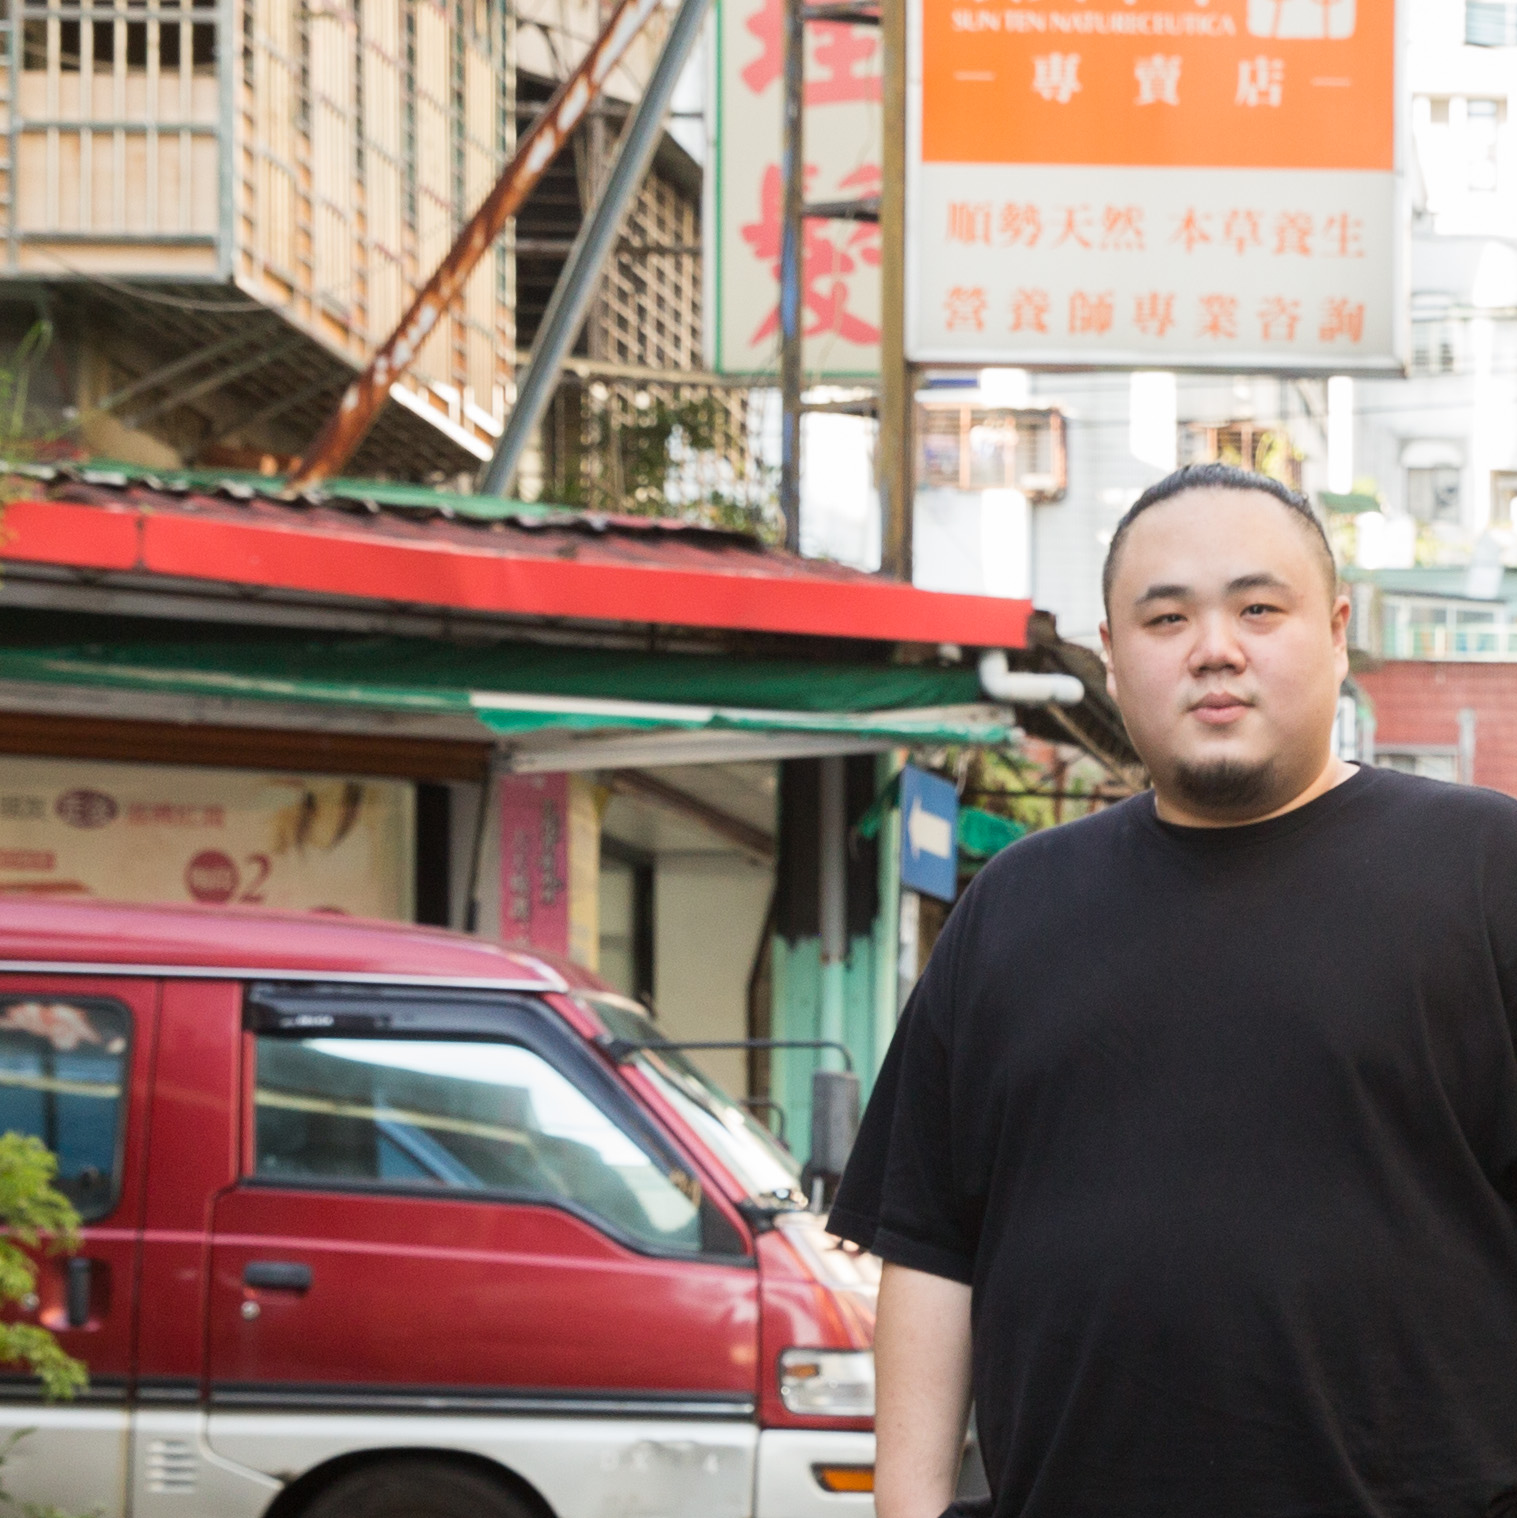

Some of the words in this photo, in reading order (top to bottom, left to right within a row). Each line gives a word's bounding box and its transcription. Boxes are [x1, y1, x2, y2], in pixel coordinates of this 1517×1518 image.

[952, 10, 999, 32] SUN
[1003, 12, 1047, 33] TEN
[1031, 52, 1285, 107] 專賣店
[945, 202, 1145, 250] 順勢天然
[1168, 207, 1366, 258] 本草養生
